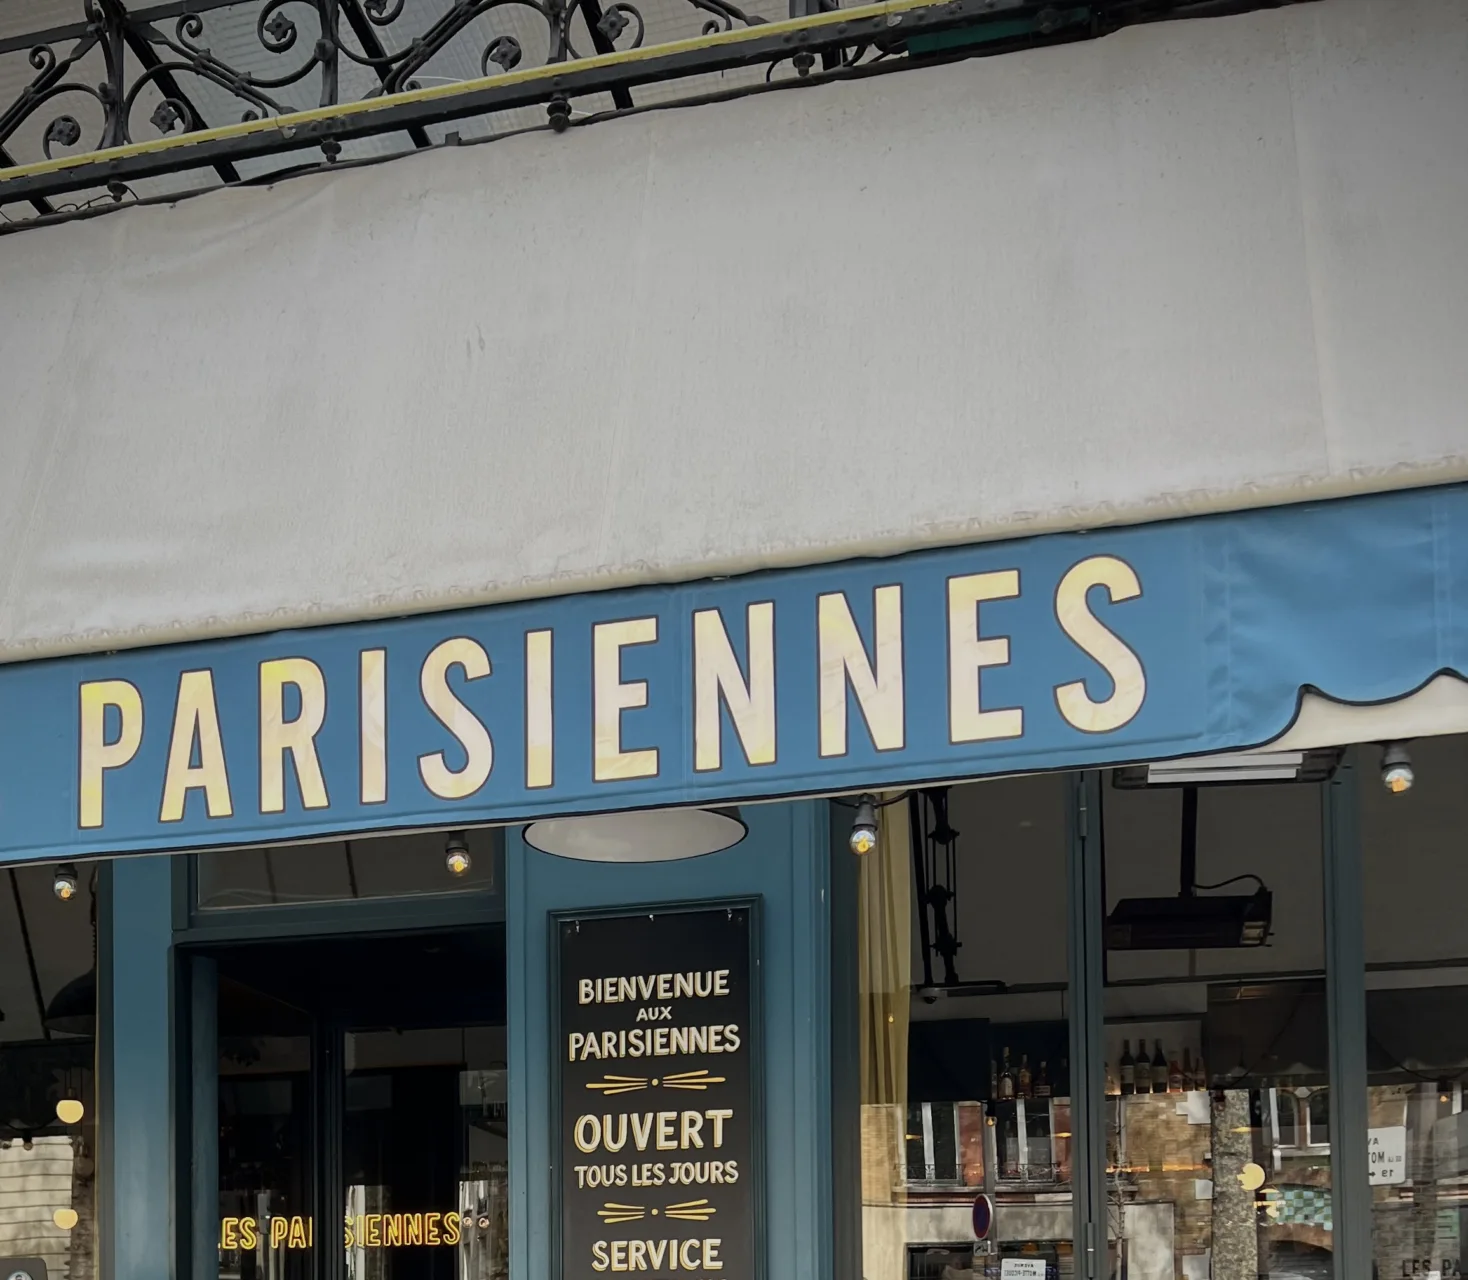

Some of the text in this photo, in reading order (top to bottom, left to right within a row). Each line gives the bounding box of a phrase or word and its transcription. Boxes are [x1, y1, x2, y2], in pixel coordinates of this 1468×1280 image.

[78, 553, 1146, 830] PARISIENNES
[578, 969, 730, 1005] BIENVENUE
[636, 1006, 673, 1022] AUX
[568, 1024, 741, 1061] PARISIENNES
[574, 1109, 733, 1153] OUVERT
[574, 1160, 739, 1189] TOUS LES JOURS
[218, 1211, 461, 1250] ES PASIENNES
[591, 1238, 723, 1272] SERVICE
